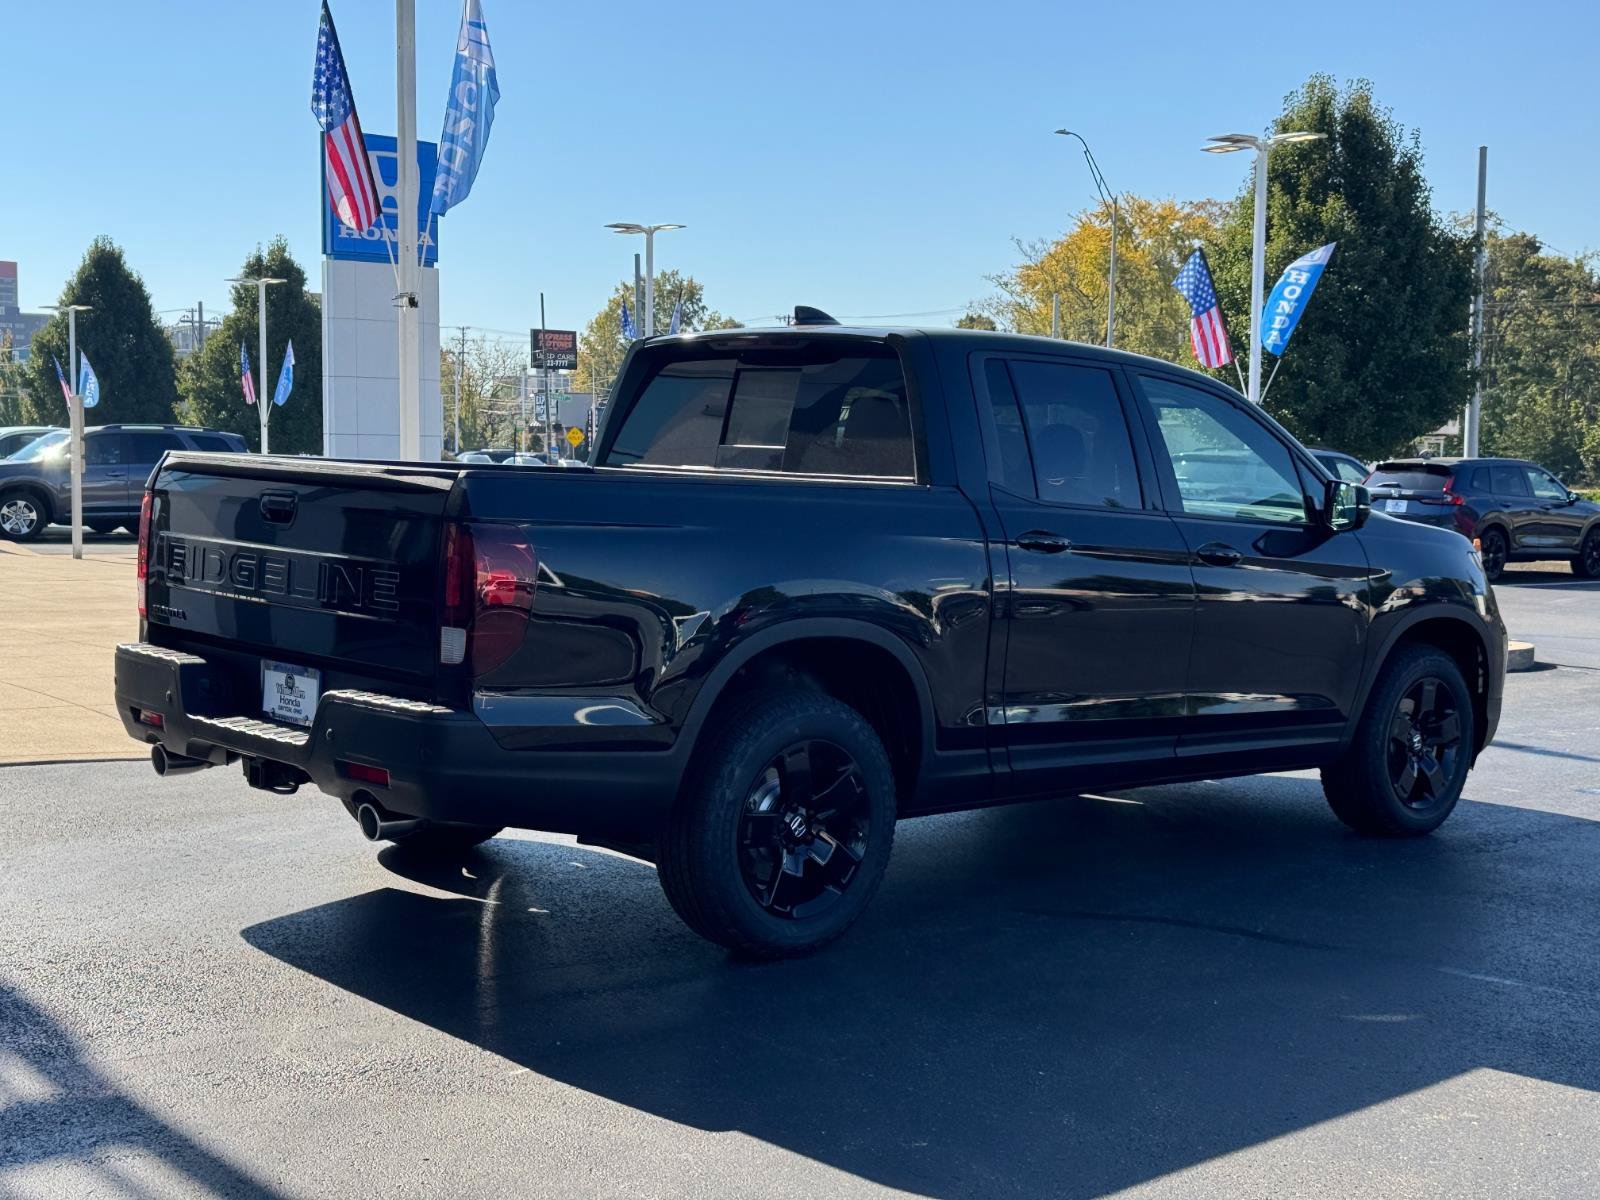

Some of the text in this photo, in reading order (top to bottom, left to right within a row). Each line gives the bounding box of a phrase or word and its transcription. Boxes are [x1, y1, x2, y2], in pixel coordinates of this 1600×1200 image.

[338, 224, 435, 246] HONA
[1267, 270, 1312, 345] HONDA
[166, 542, 401, 612] RIDGELINE
[279, 695, 301, 707] Honda
